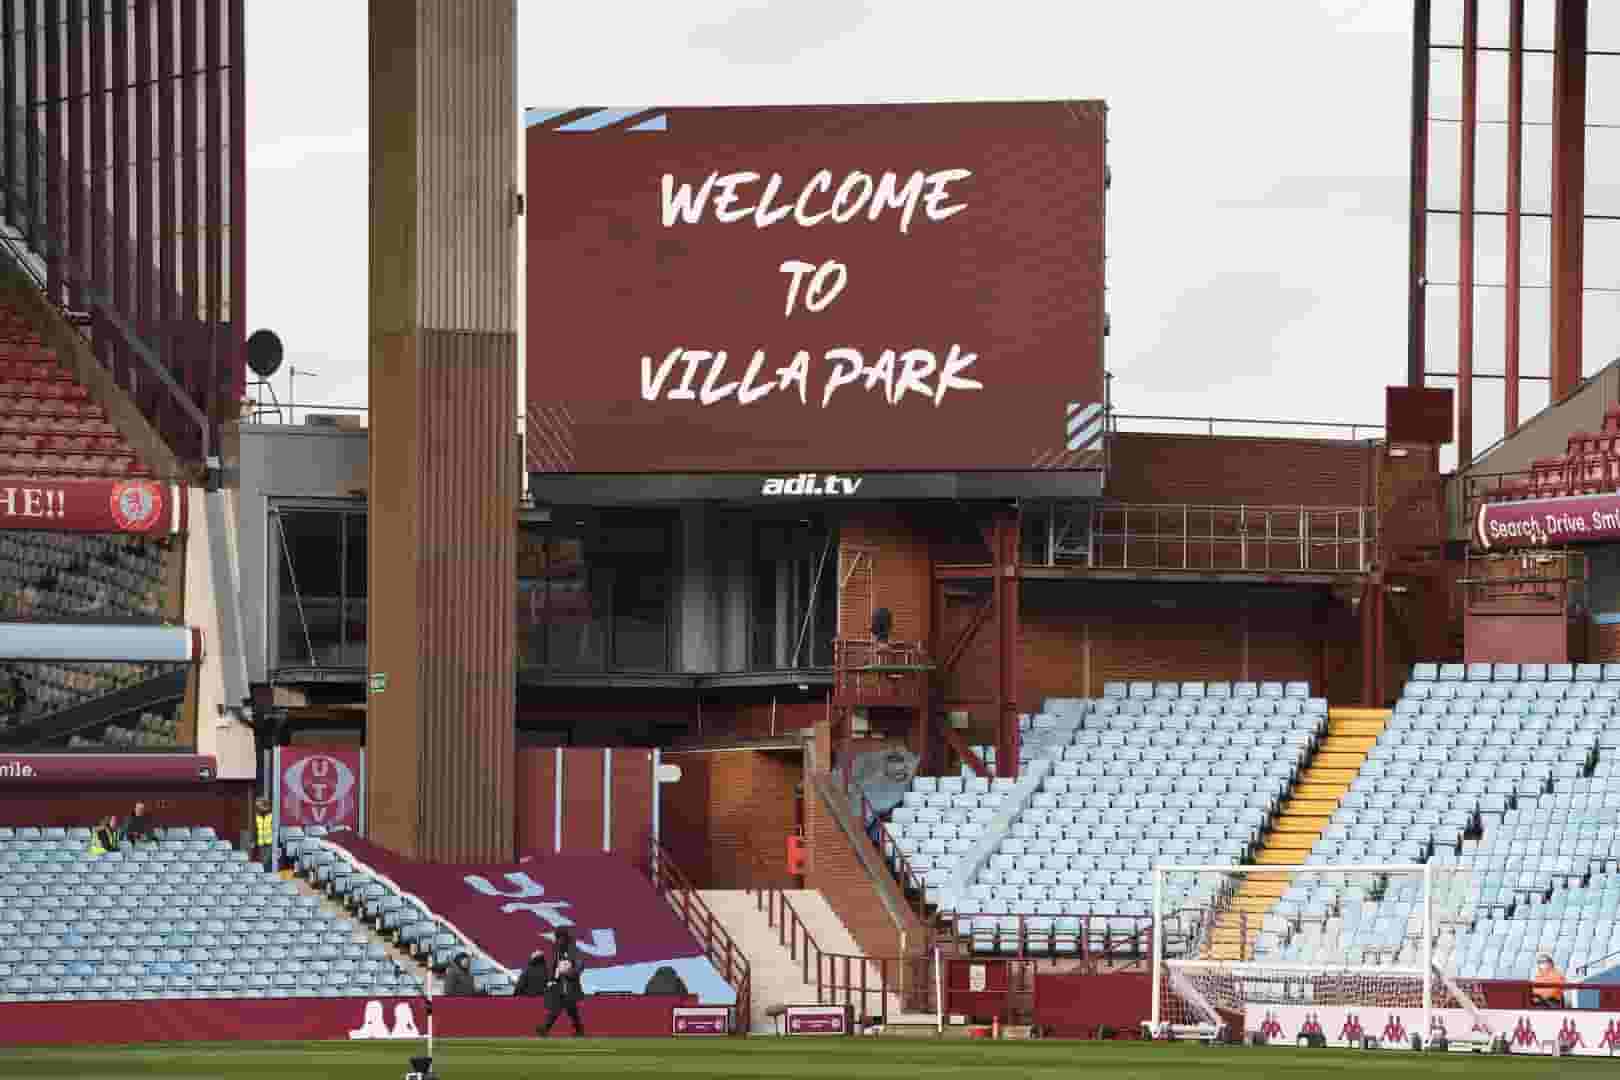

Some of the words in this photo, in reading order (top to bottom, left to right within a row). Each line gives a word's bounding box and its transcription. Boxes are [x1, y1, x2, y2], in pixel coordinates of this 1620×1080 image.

[661, 168, 972, 233] WELCOME
[779, 259, 847, 317] TO
[640, 346, 810, 405] VILLA
[821, 343, 984, 409] PARK
[761, 473, 862, 496] adi.tv
